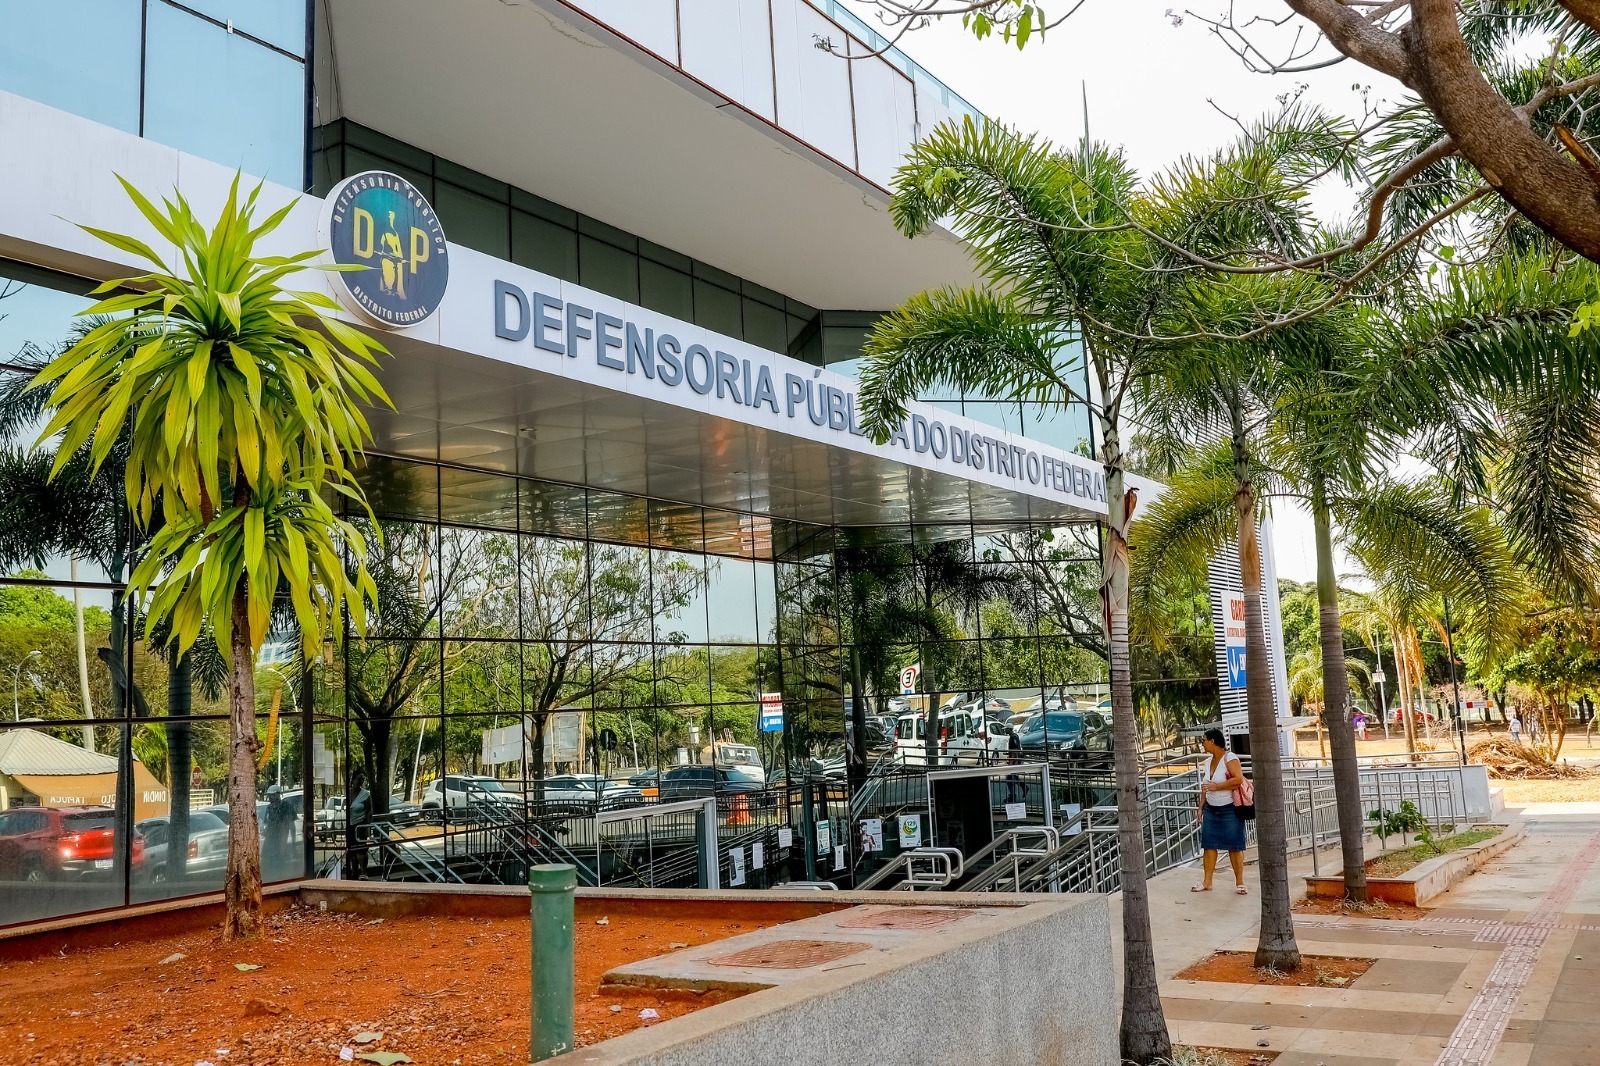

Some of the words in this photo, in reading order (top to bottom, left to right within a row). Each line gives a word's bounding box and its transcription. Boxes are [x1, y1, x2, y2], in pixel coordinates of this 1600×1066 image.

[334, 176, 399, 224] DEFENSORIA
[353, 285, 392, 320] DISTRITO
[395, 305, 428, 322] FEDERAL
[494, 279, 780, 414] DEFENSORIA
[786, 369, 910, 450] PÚBLA
[914, 413, 948, 459] DO
[950, 425, 1041, 485] DISTRITO
